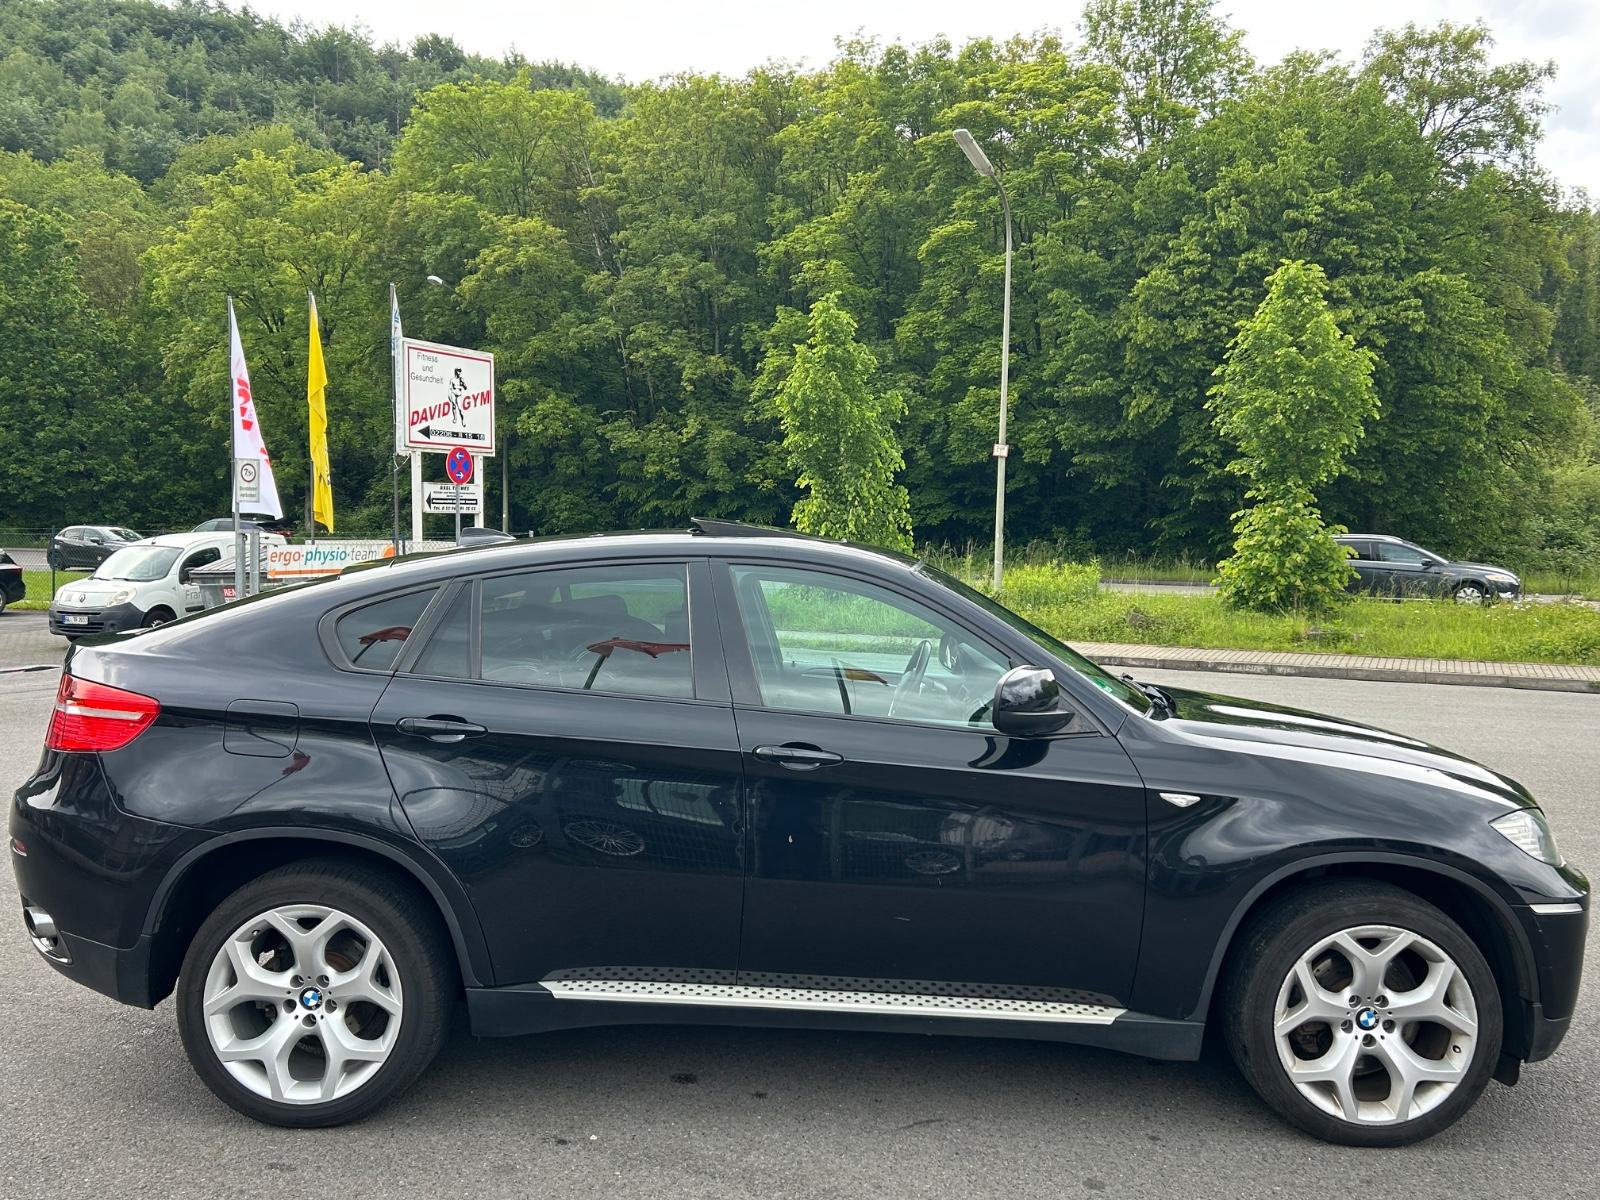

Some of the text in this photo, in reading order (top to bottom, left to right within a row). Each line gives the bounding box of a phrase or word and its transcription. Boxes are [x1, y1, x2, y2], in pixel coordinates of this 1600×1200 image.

[416, 352, 438, 363] Fitness
[422, 365, 433, 373] und
[410, 372, 443, 384] Gesundheit
[411, 390, 490, 426] DAVID GYM
